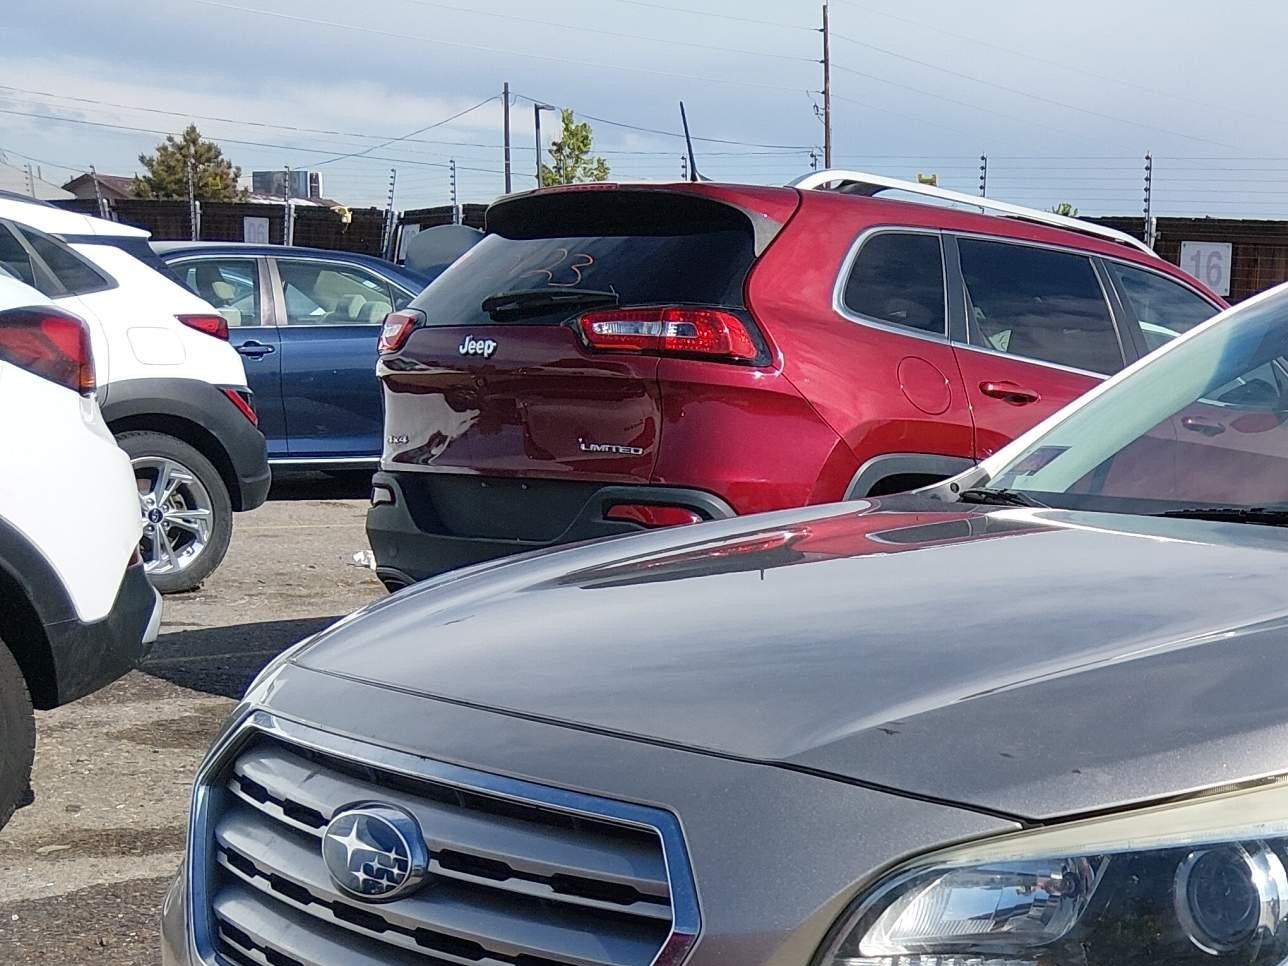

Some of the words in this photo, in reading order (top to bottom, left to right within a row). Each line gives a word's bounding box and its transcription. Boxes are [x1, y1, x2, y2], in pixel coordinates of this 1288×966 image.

[1190, 249, 1223, 288] 16
[458, 334, 497, 358] Jeep
[578, 437, 644, 455] LIMITED
